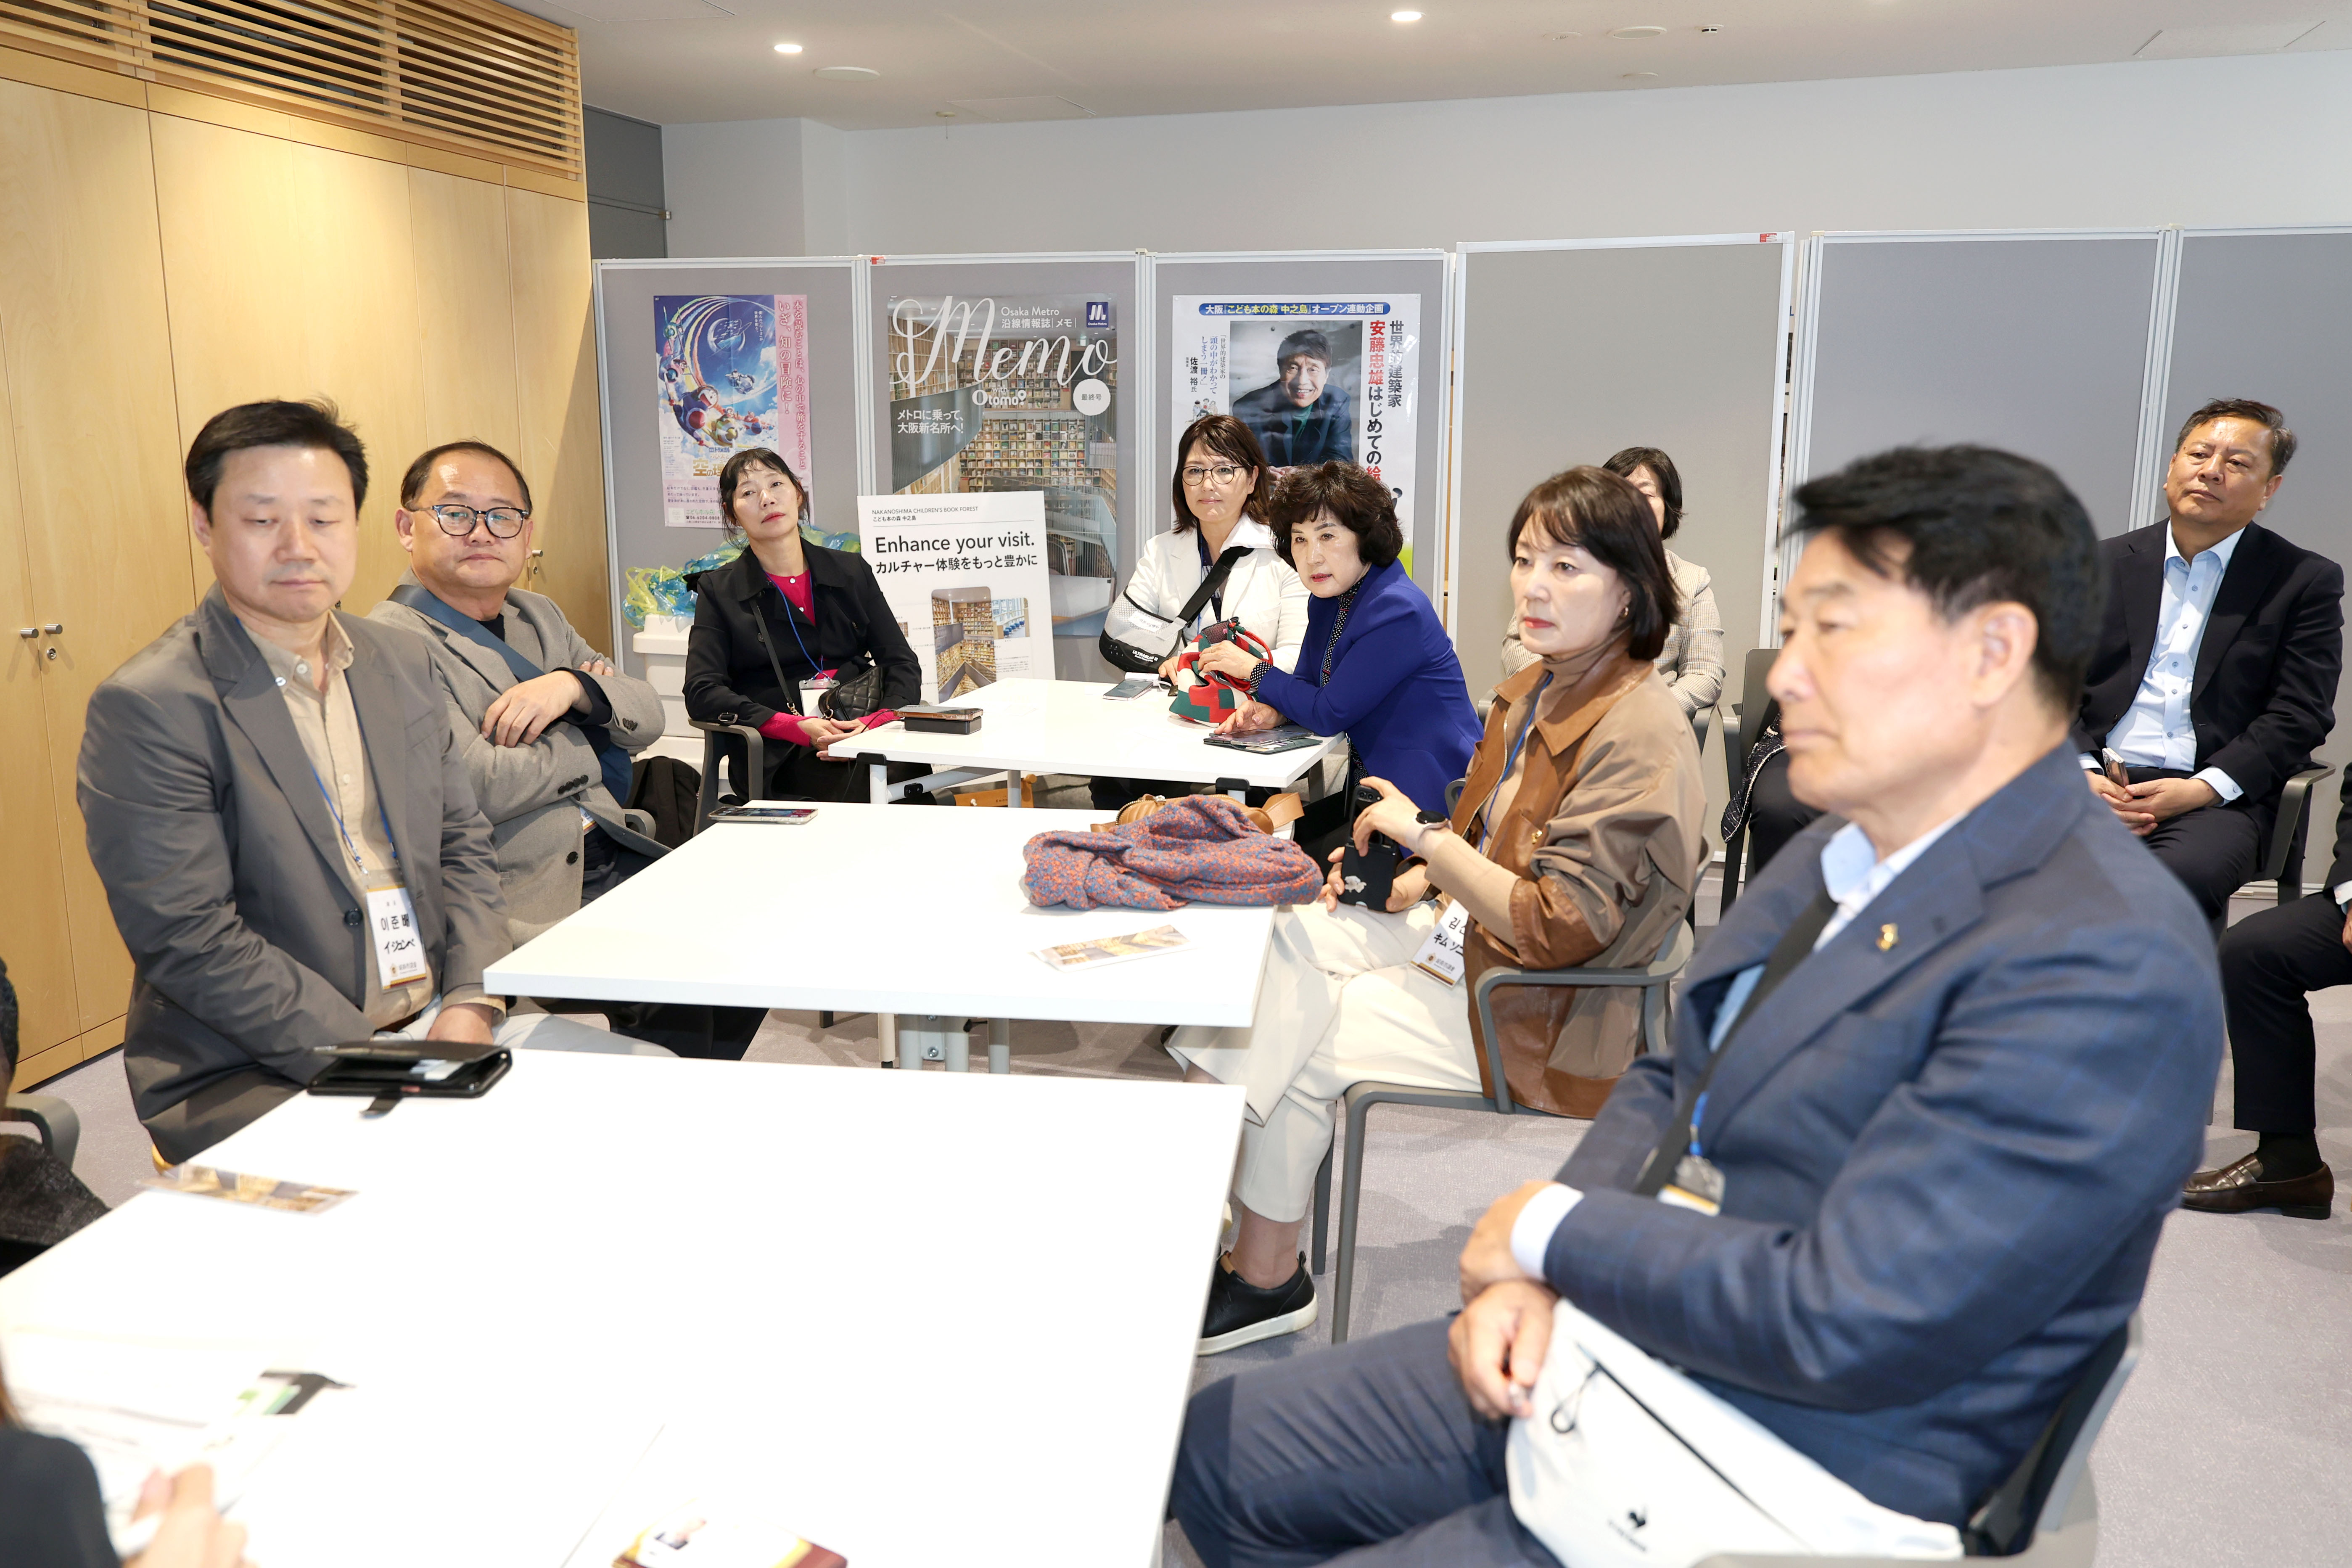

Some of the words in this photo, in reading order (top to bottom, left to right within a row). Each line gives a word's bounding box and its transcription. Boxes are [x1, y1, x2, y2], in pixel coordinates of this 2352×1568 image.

[1001, 307, 1029, 316] Osaka
[1031, 306, 1060, 316] Metro
[889, 296, 1117, 386] Memo
[1210, 336, 1218, 394] 頭の中がわかって
[1387, 320, 1404, 407] 世界的建築家
[793, 300, 806, 469] 本を読むことは、心の中で旅をすること
[897, 409, 964, 420] メトロに乗って、
[898, 423, 964, 434] 大阪新名所へ!
[875, 535, 950, 553] Enhance
[956, 536, 993, 554] your
[998, 531, 1035, 547] visit.
[876, 554, 1038, 574] カルチャー体験をもっと豊かに
